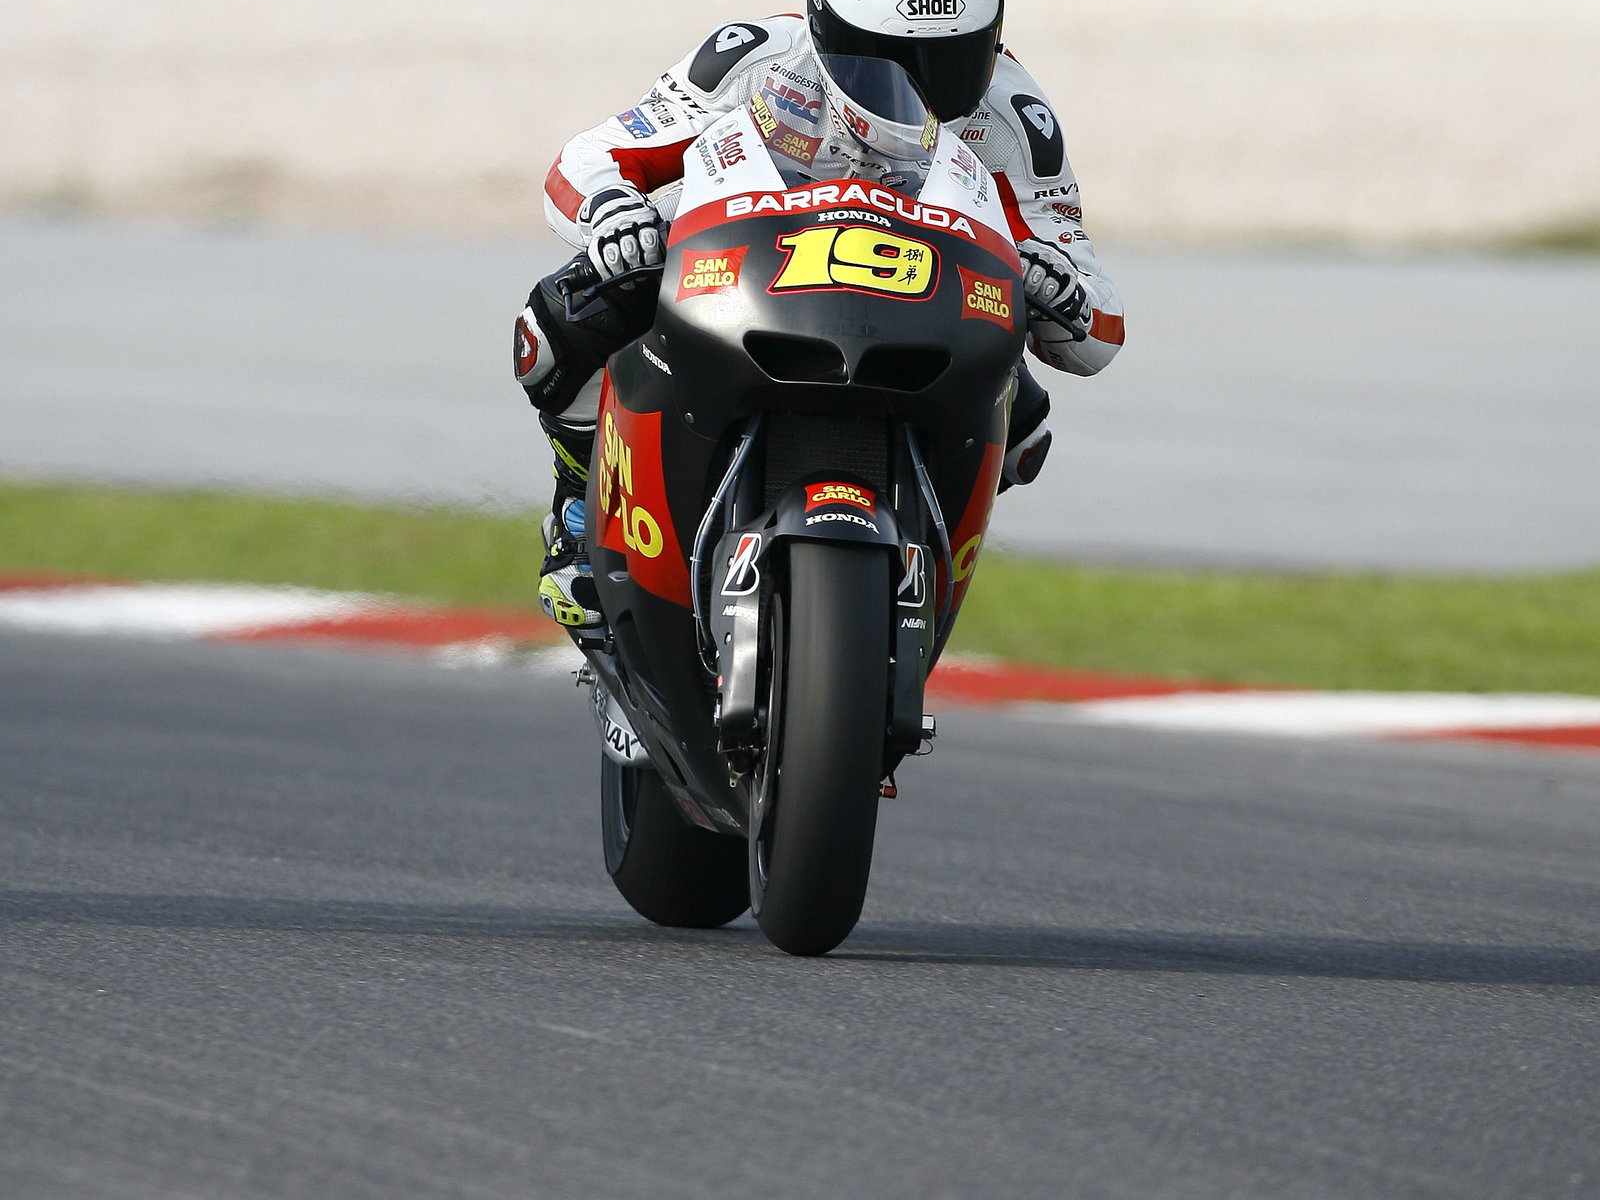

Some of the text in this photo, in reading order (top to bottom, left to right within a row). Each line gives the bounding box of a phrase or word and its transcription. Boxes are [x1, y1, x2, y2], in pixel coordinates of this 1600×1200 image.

[772, 139, 811, 161] CARLO
[783, 133, 809, 150] SAN
[726, 183, 978, 240] BARRACUDA
[818, 210, 893, 228] HONDA
[693, 257, 729, 274] SAN
[770, 225, 936, 298] 19
[682, 270, 735, 290] CARLO
[974, 280, 1002, 301] SAN
[967, 293, 1010, 319] CARLO
[642, 343, 672, 376] HONDA
[812, 492, 871, 506] CARLO
[822, 485, 861, 496] SAN
[805, 513, 880, 534] HONDA
